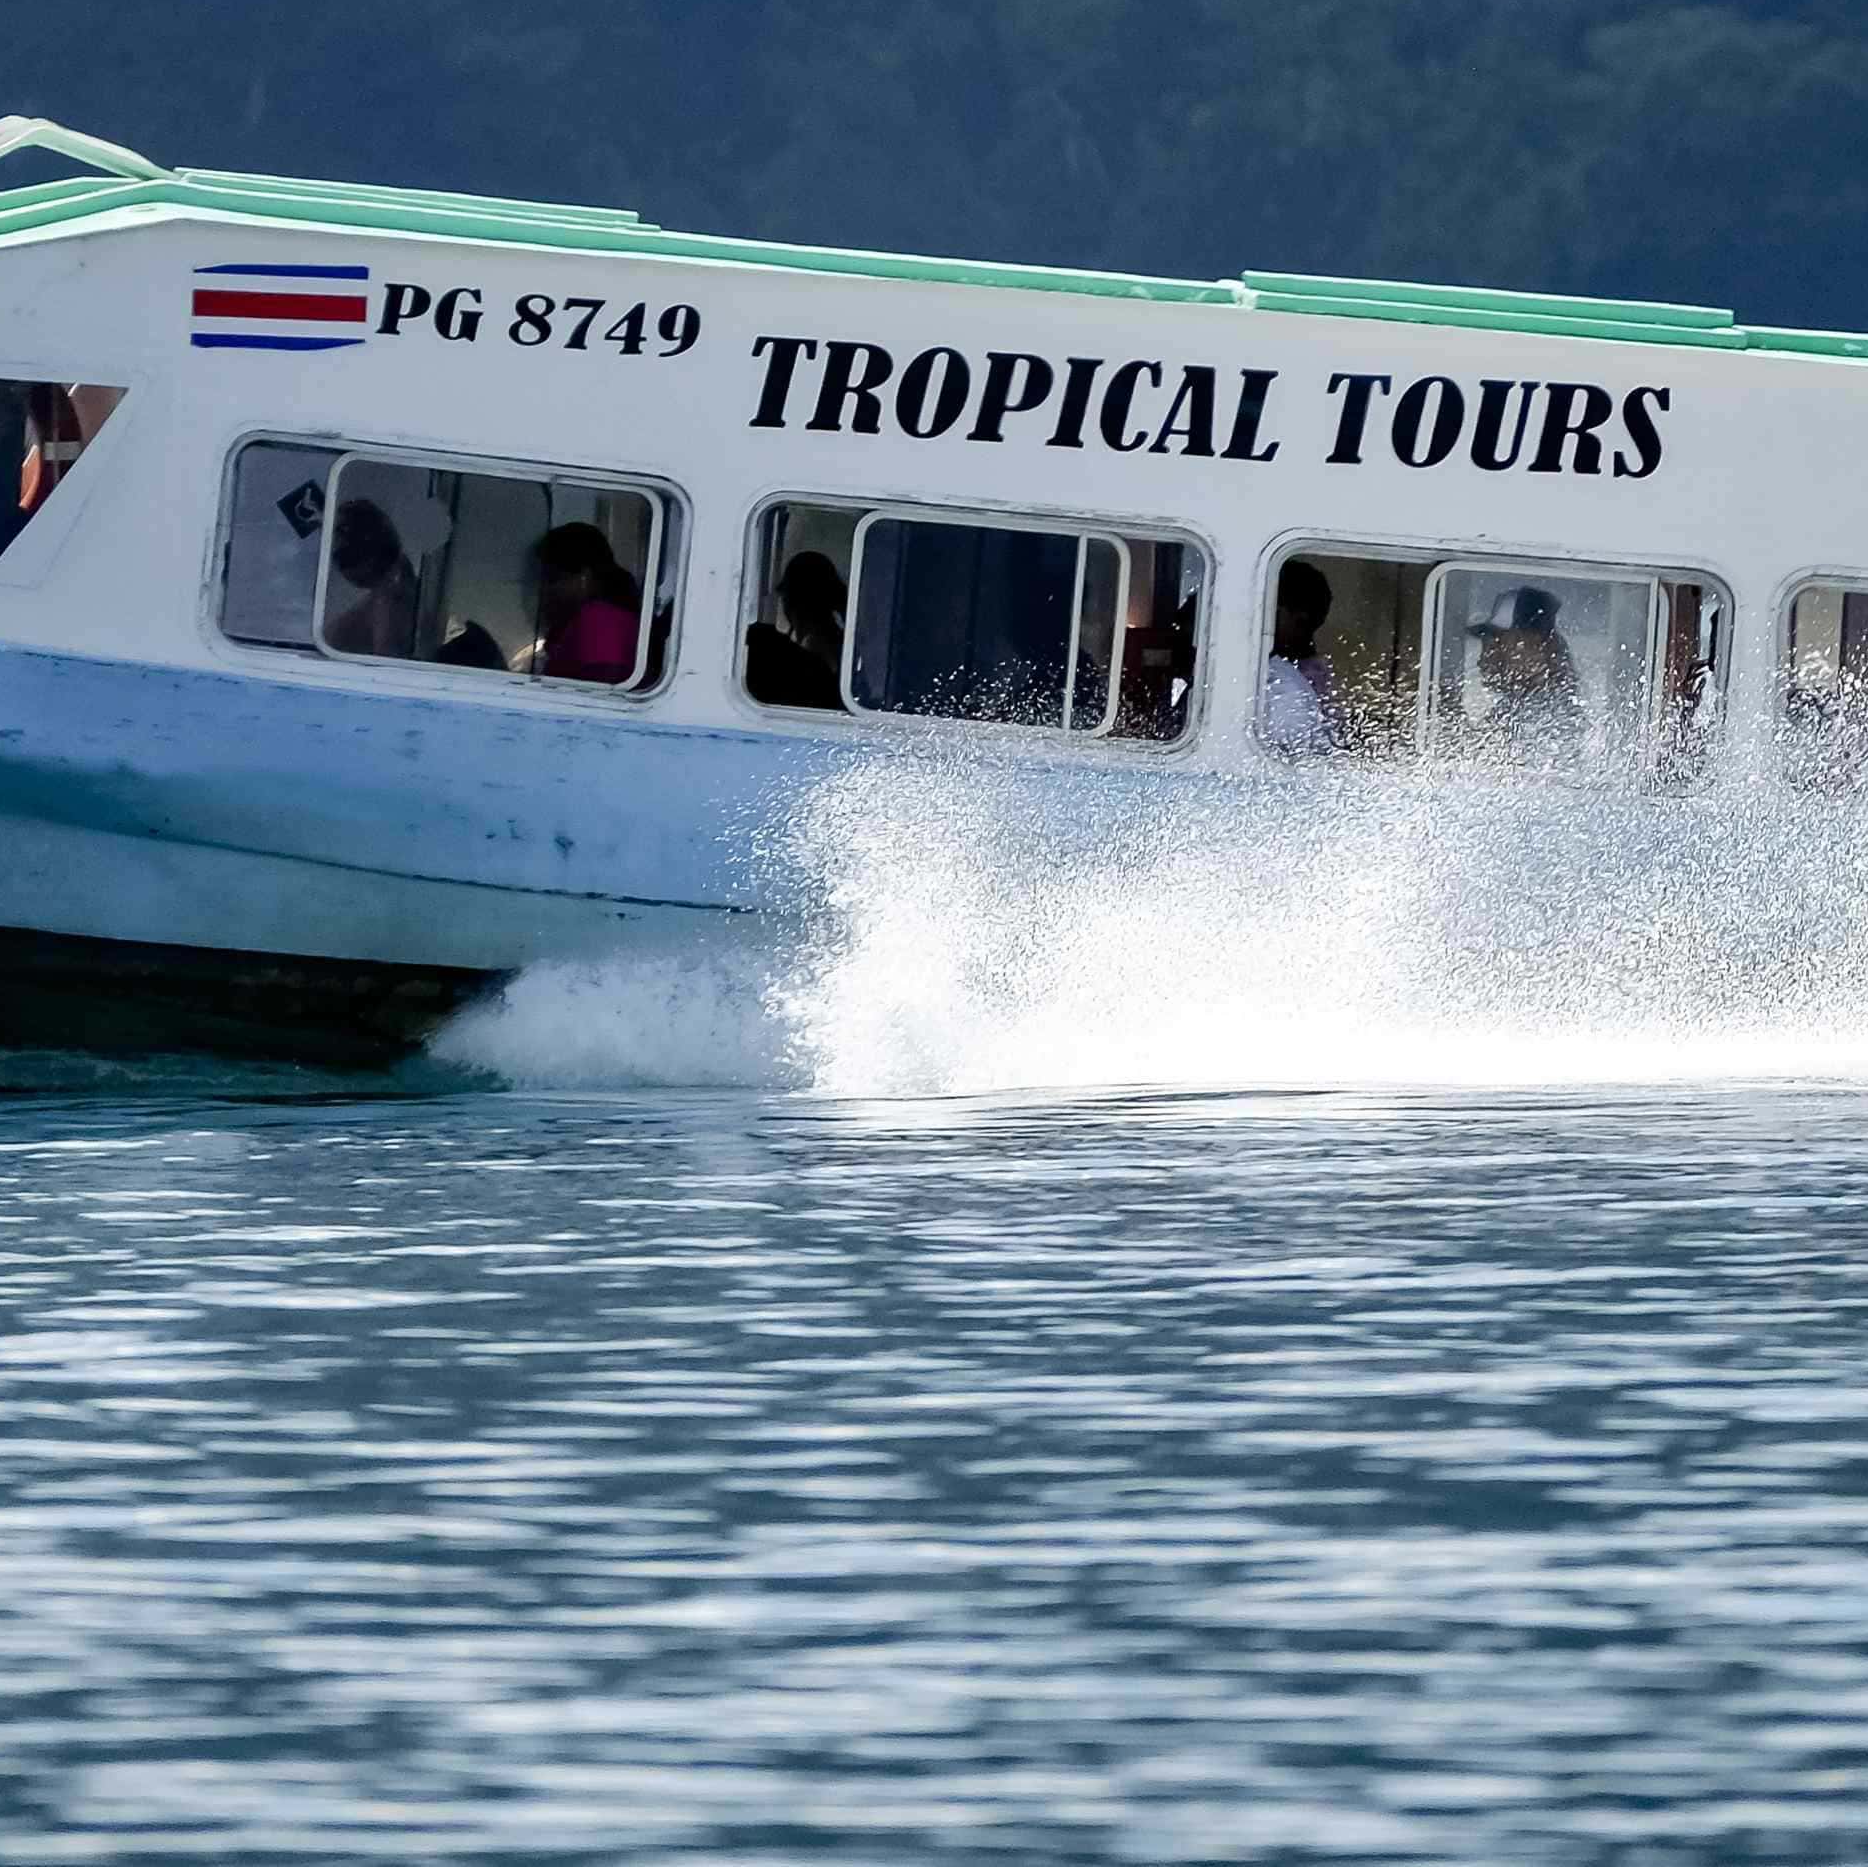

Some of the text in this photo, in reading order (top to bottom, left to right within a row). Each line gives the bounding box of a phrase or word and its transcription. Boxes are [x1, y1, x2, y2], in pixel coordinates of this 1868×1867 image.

[375, 283, 701, 358] PG 8749
[748, 336, 1670, 479] TROPICAL TOURS
